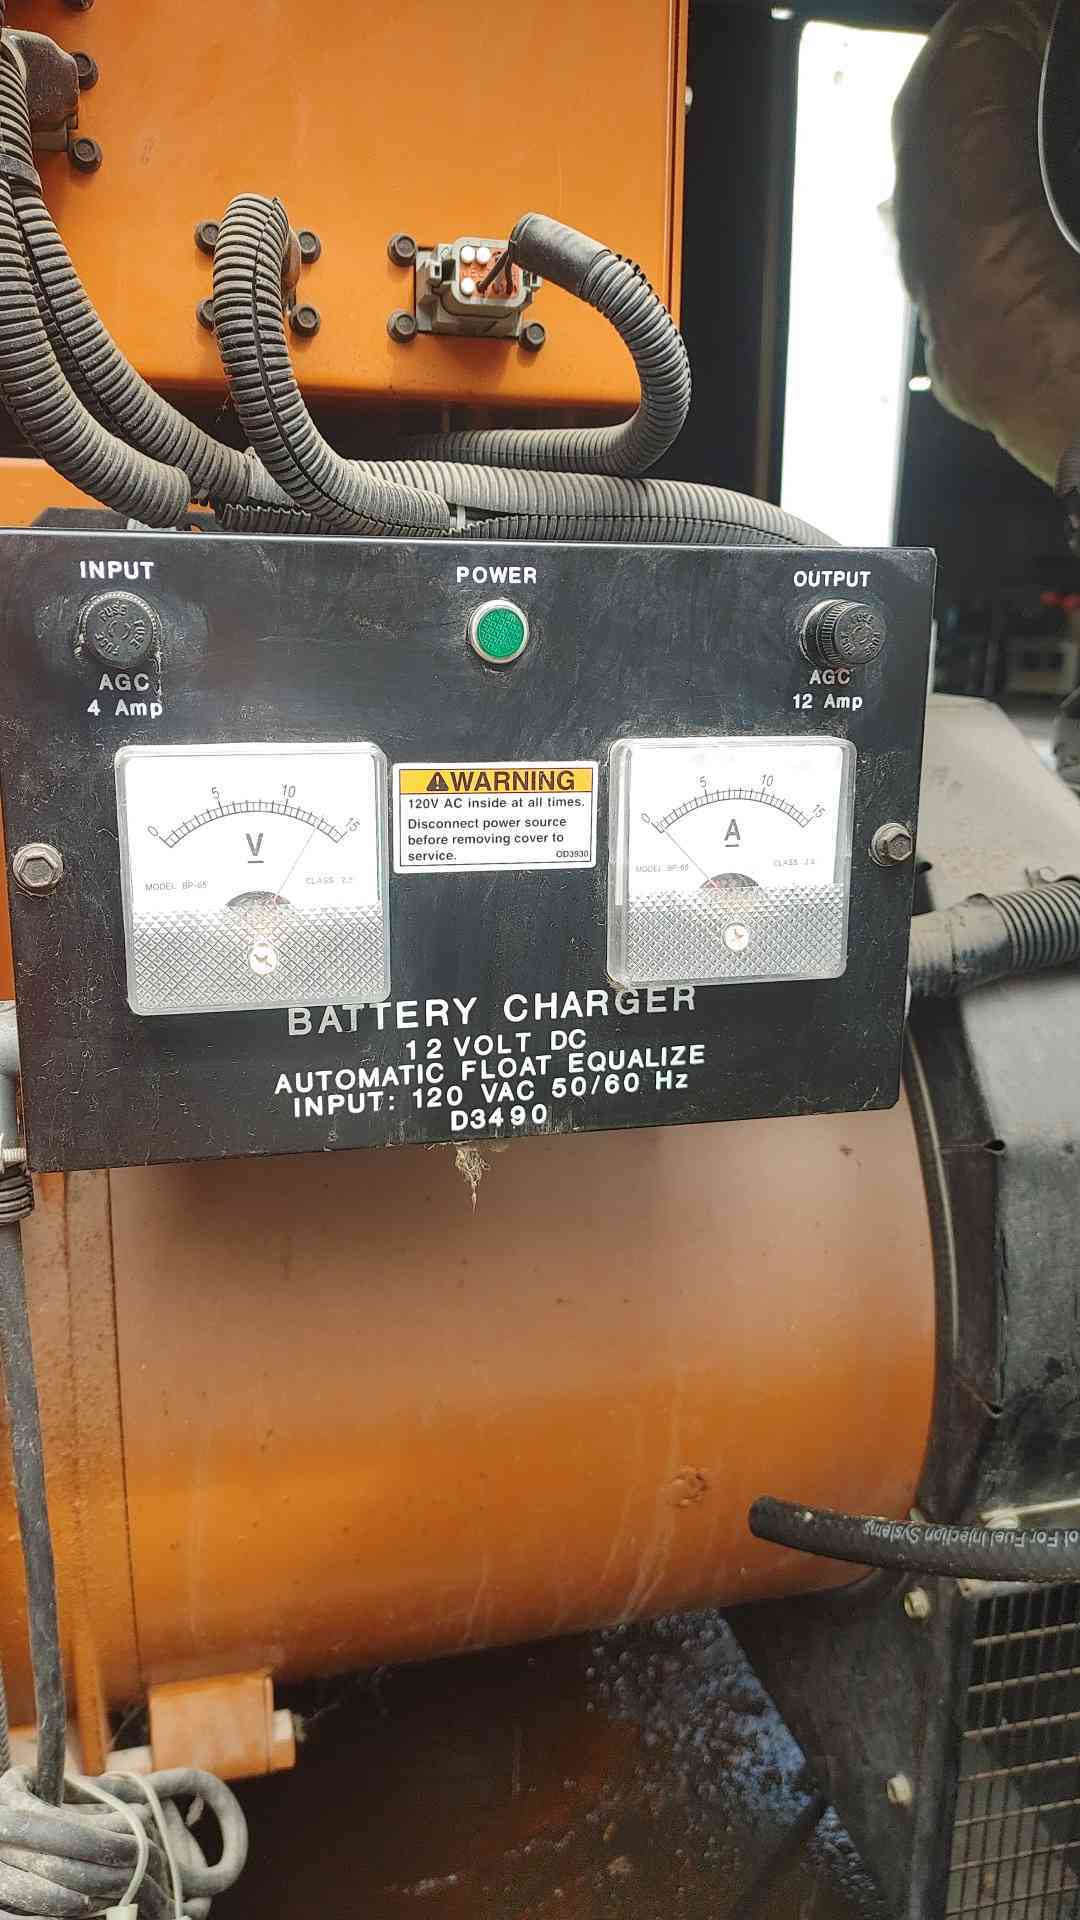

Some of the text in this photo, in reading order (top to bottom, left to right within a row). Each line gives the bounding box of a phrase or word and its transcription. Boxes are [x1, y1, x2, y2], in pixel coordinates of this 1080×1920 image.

[79, 560, 154, 580] INPUT
[456, 566, 537, 584] POWER
[793, 570, 872, 588] OUTPUT
[99, 673, 150, 691] AGC
[809, 669, 851, 685] AGC
[87, 699, 163, 719] 4 Amp
[793, 693, 863, 711] 12 Amp
[450, 770, 575, 791] WARNING
[699, 776, 708, 788] 5
[761, 774, 774, 787] 10
[211, 786, 221, 799] 5
[282, 784, 296, 798] 10
[408, 797, 585, 809] 120V AC inside at all times.
[812, 804, 826, 818] 15
[346, 817, 361, 833] 15
[408, 818, 567, 830] Disconnect power source
[641, 812, 651, 824] 0
[147, 825, 159, 838] 0
[408, 832, 564, 846] before removing cover to
[724, 819, 741, 841] A
[246, 833, 264, 857] V
[408, 851, 457, 861] service.
[145, 883, 177, 892] MODEL
[305, 876, 335, 885] CLASS
[288, 985, 695, 1036] BATTERY CHARGER
[405, 1029, 587, 1060] 12 VOLT DC
[274, 1045, 705, 1095] AUTOMATIC FLOAT EQUALIZE
[293, 1070, 688, 1118] INPUT: 120 VAC 50/60 Hz
[451, 1103, 547, 1132] D3490
[862, 1519, 922, 1545] Systems
[924, 1526, 988, 1548] Injection
[990, 1530, 1026, 1549] Fuel
[1031, 1530, 1059, 1548] For
